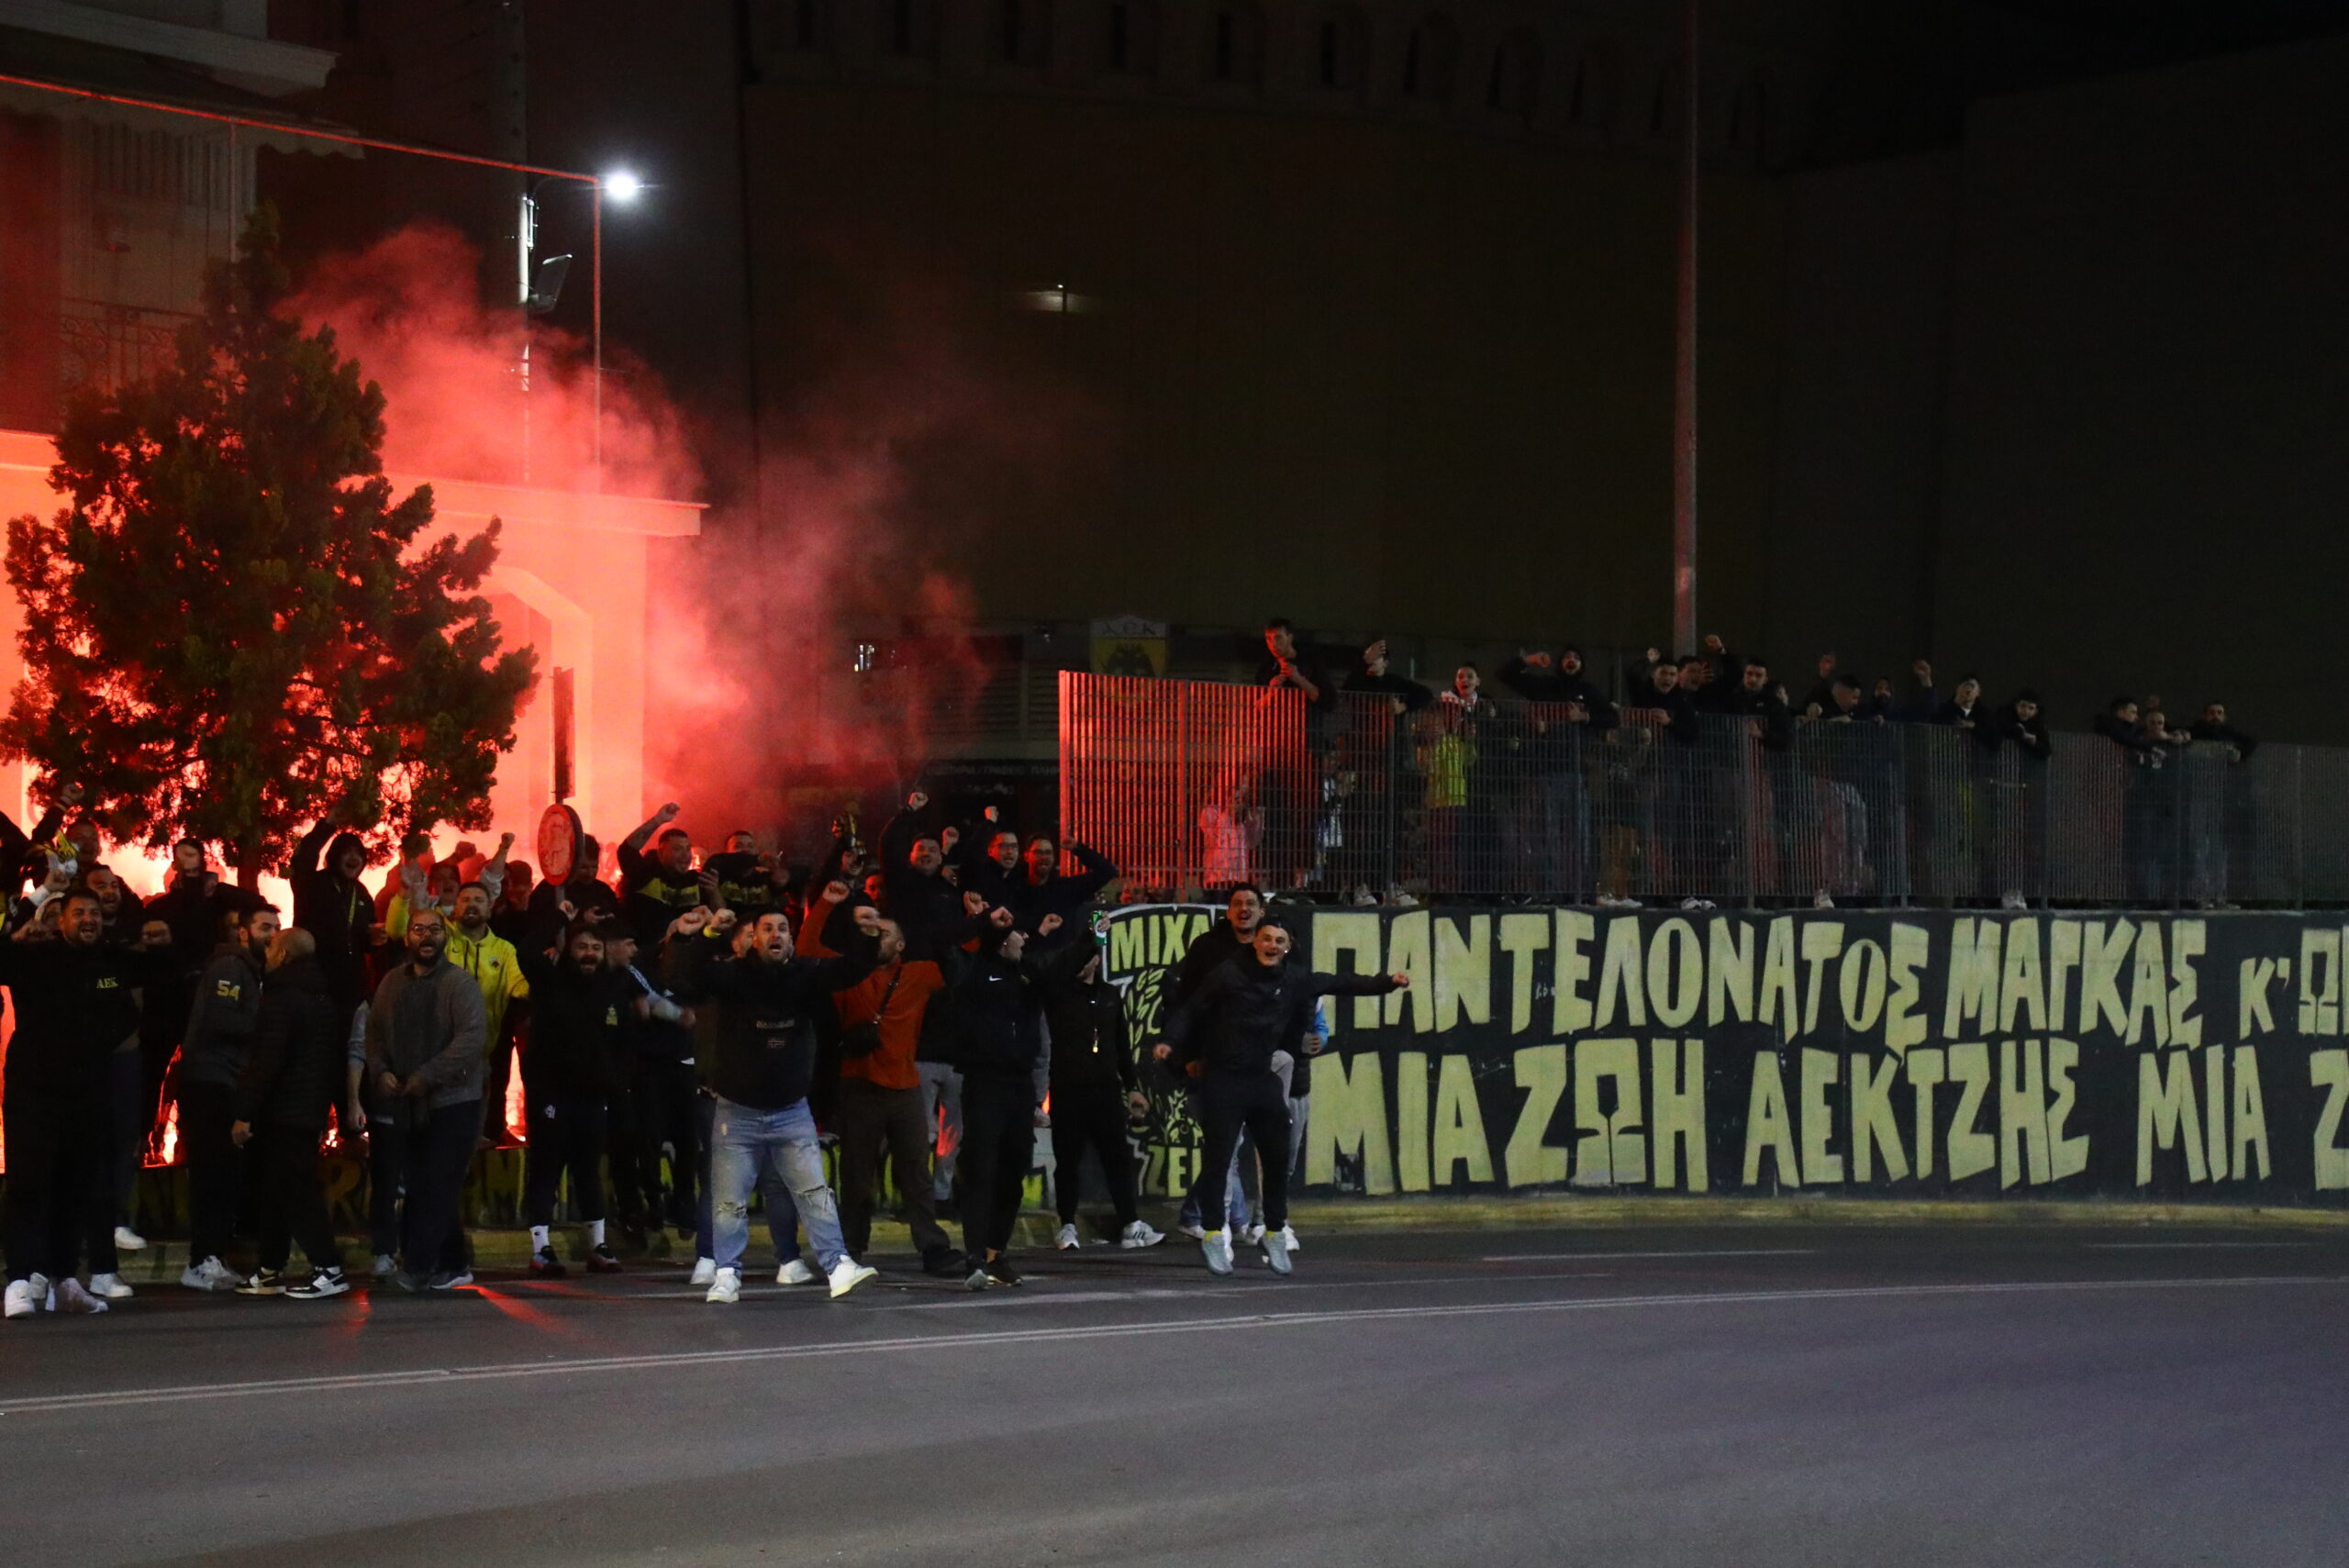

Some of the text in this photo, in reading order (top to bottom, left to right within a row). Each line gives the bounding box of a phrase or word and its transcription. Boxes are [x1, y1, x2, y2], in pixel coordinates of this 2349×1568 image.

[216, 979, 241, 1001] 54
[1943, 917, 2207, 1051] ΜΑΓΚΑΣ
[1305, 1051, 1494, 1194] ΜΙΑ
[1505, 1038, 1709, 1192] ΖΩΗ
[1743, 1038, 2089, 1190] ΑΕΚΤΖΗΣ
[2136, 1044, 2271, 1188] ΜΙΑ
